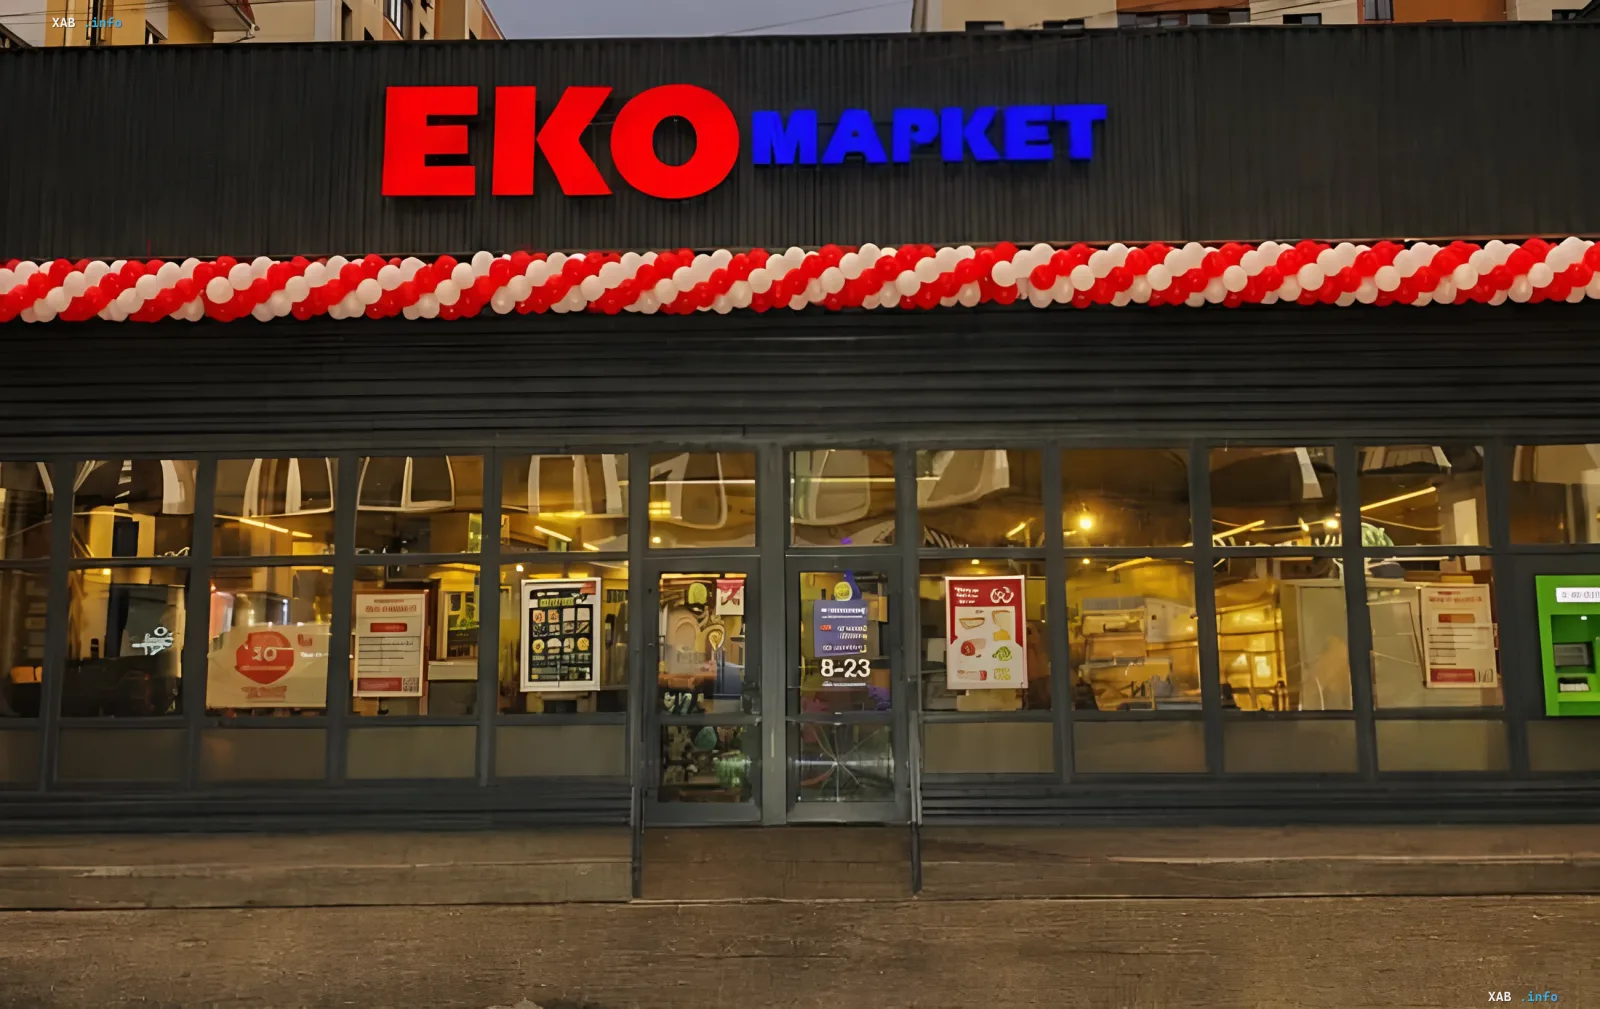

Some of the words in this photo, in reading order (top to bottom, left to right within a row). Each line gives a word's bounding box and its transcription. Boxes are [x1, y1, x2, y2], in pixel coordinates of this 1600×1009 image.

[382, 84, 739, 199] ЕКО
[752, 104, 1107, 165] МАРКЕТ
[820, 658, 871, 678] 8-23
